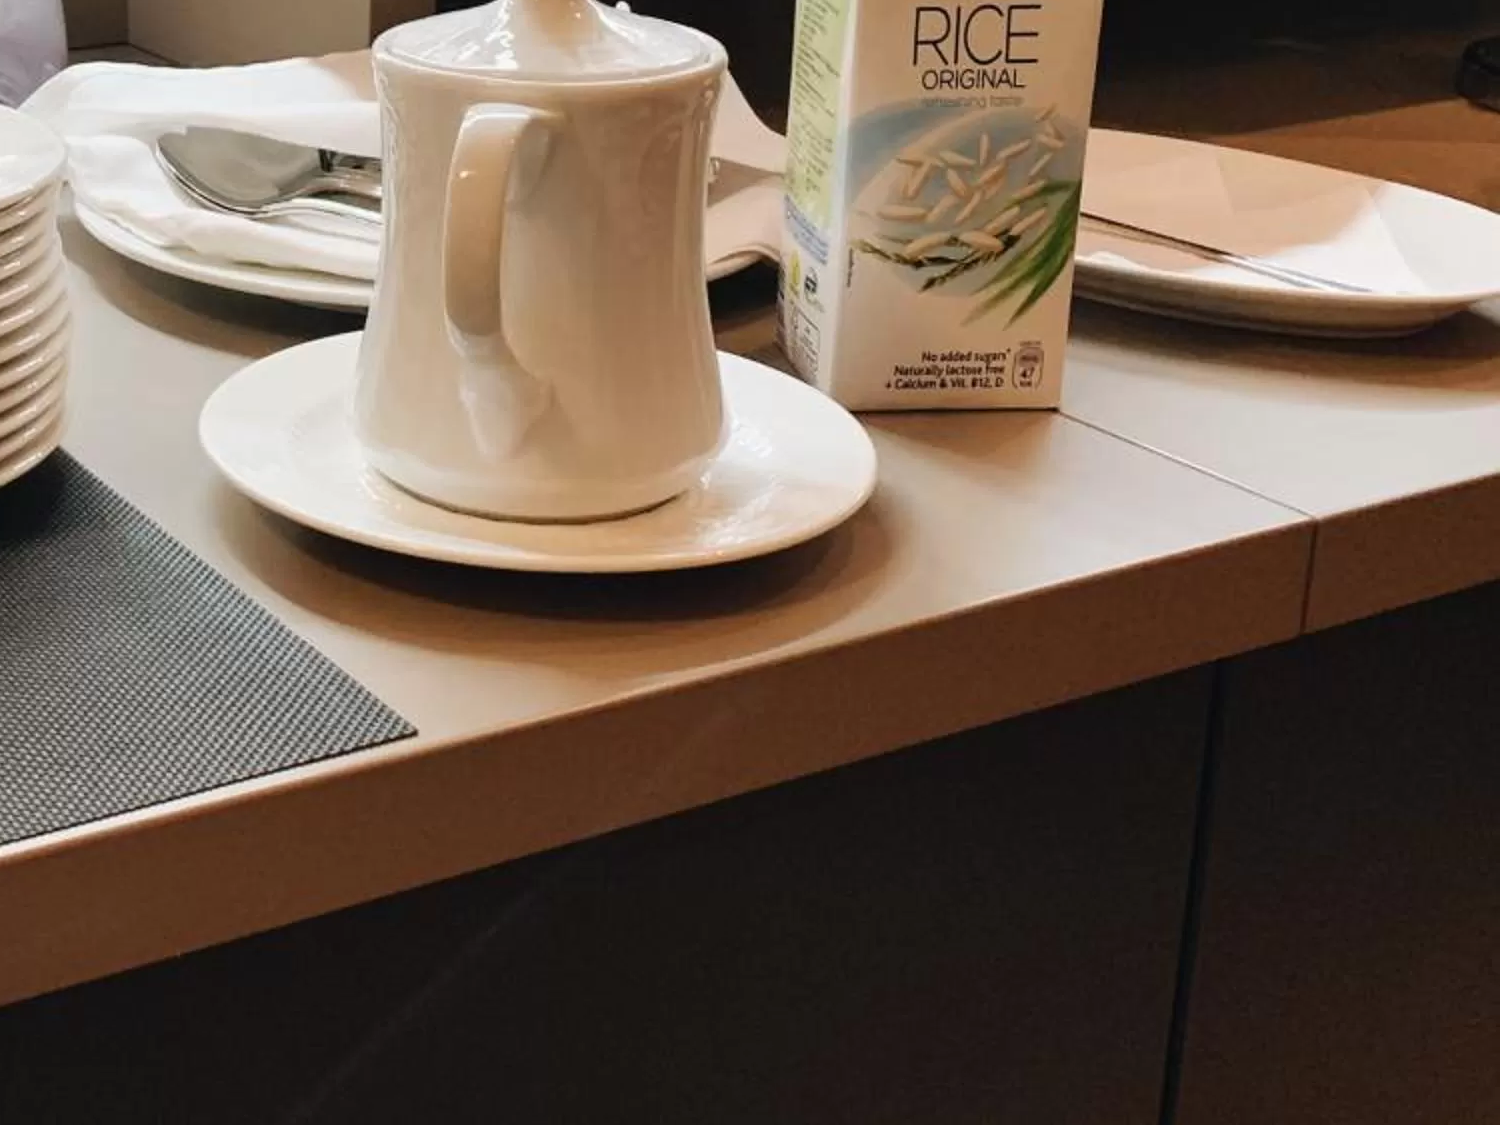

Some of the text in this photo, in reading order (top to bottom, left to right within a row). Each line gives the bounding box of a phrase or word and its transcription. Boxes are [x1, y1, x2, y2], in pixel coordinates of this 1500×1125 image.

[913, 4, 1042, 66] RICE
[921, 68, 1027, 90] ORIGINAL
[921, 351, 938, 362] No
[940, 351, 972, 362] added
[893, 364, 1005, 378] Naturally lactose free
[895, 378, 937, 389] Calcium
[939, 378, 948, 388] &
[995, 376, 1004, 387] D
